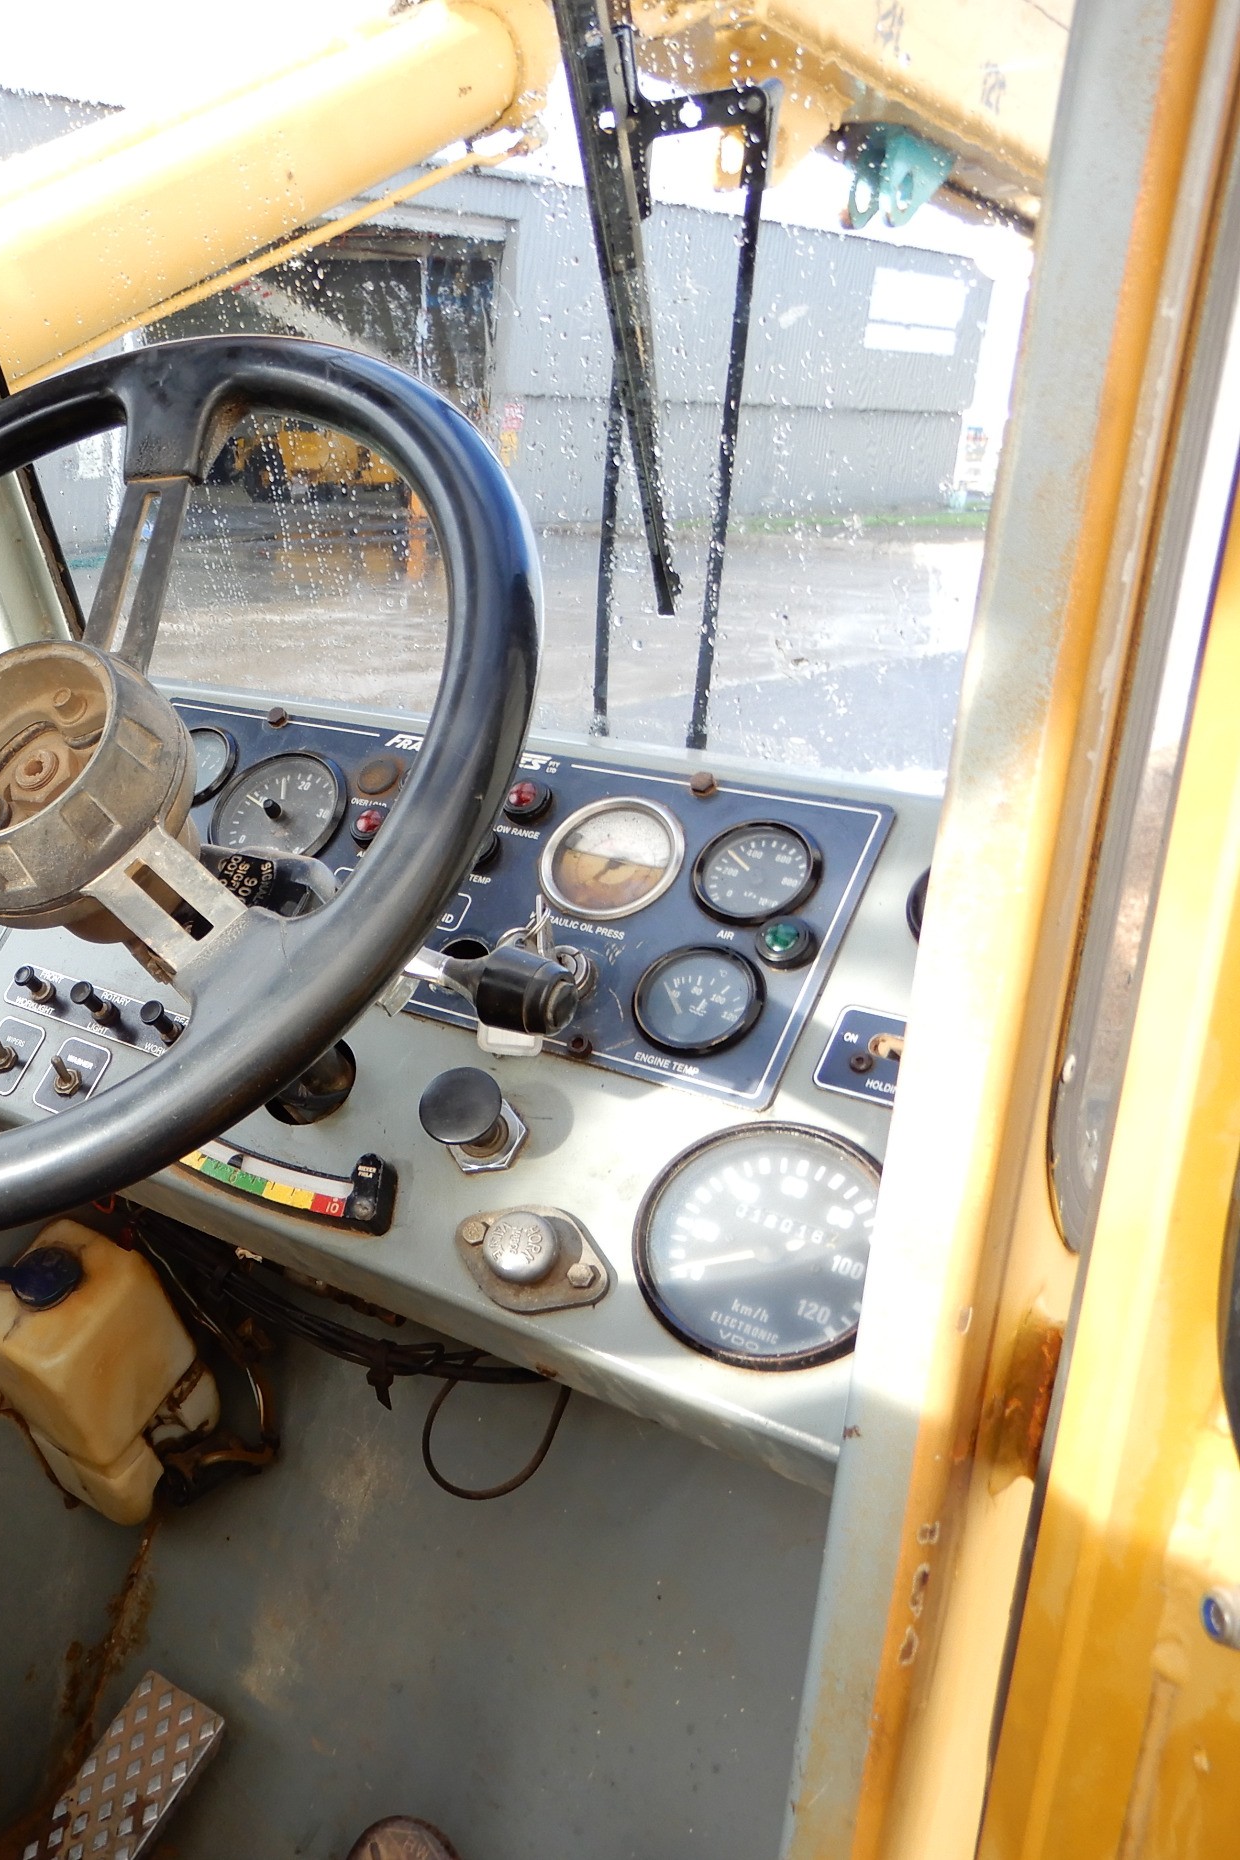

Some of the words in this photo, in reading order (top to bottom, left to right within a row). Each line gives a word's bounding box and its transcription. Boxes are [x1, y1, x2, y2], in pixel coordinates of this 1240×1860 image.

[297, 780, 312, 791] 20
[316, 808, 331, 819] 30
[238, 834, 246, 844] 0
[492, 824, 511, 836] LOW
[510, 827, 541, 840] RANGE
[746, 849, 764, 860] 400
[775, 854, 792, 865] 600
[721, 866, 739, 877] 200
[468, 873, 491, 885] TEMP
[726, 889, 734, 898] 0
[579, 922, 594, 934] OIL
[594, 924, 626, 941] PRESS
[716, 929, 735, 941] AIR
[40, 969, 63, 985] FRONT
[15, 995, 56, 1016] WORKLIGHT
[100, 991, 131, 1007] ROTARY
[86, 1021, 110, 1036] LIGHT
[6, 1035, 26, 1048] WIPERS
[843, 1031, 859, 1044] ON
[634, 1051, 671, 1070] ENGINE
[672, 1061, 700, 1077] TEMP
[325, 1202, 340, 1214] 10
[831, 1253, 865, 1280] 100
[730, 1298, 769, 1324] km/h
[794, 1298, 831, 1325] 120
[710, 1310, 779, 1346] ELECTRONIC
[717, 1327, 761, 1351] VDO
